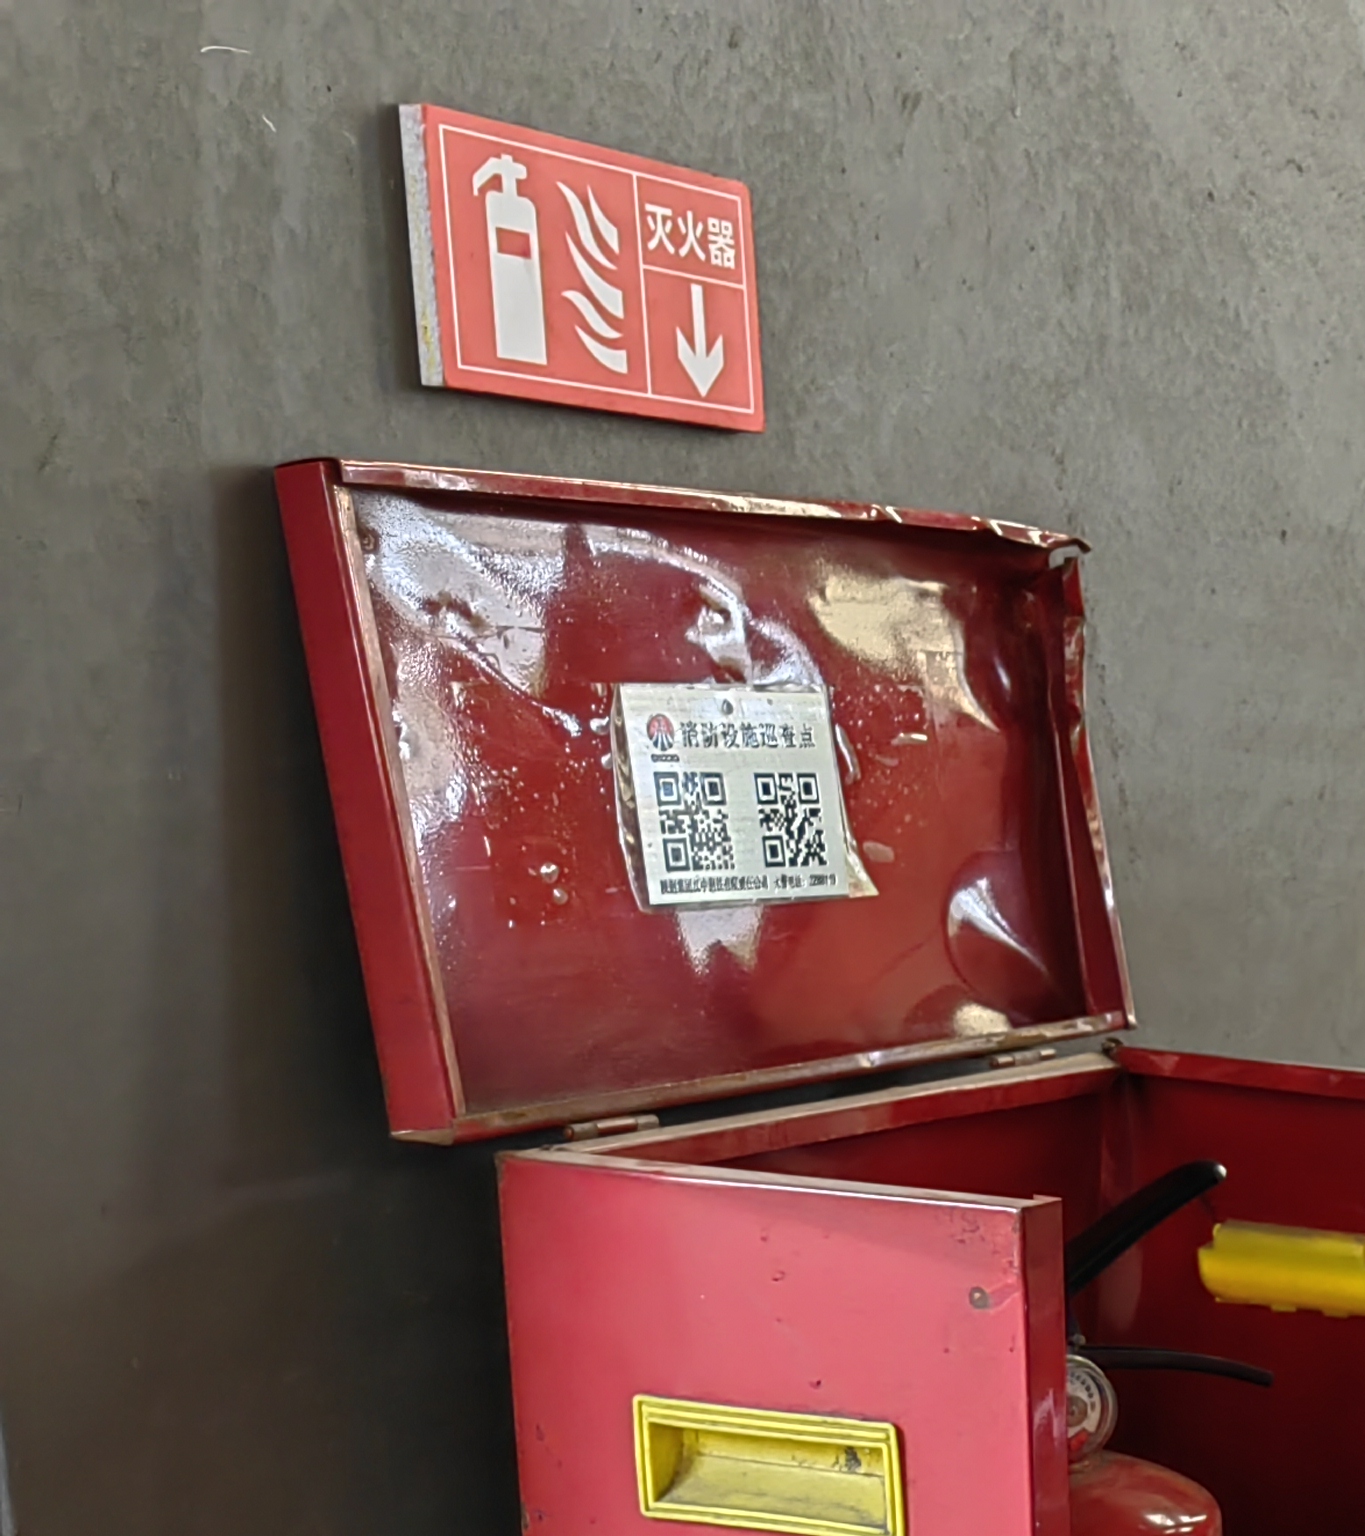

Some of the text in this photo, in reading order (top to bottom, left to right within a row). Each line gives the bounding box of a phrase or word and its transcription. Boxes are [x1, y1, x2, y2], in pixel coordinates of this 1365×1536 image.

[644, 203, 737, 270] 灭火器
[679, 719, 816, 749] 消防设施巡查点
